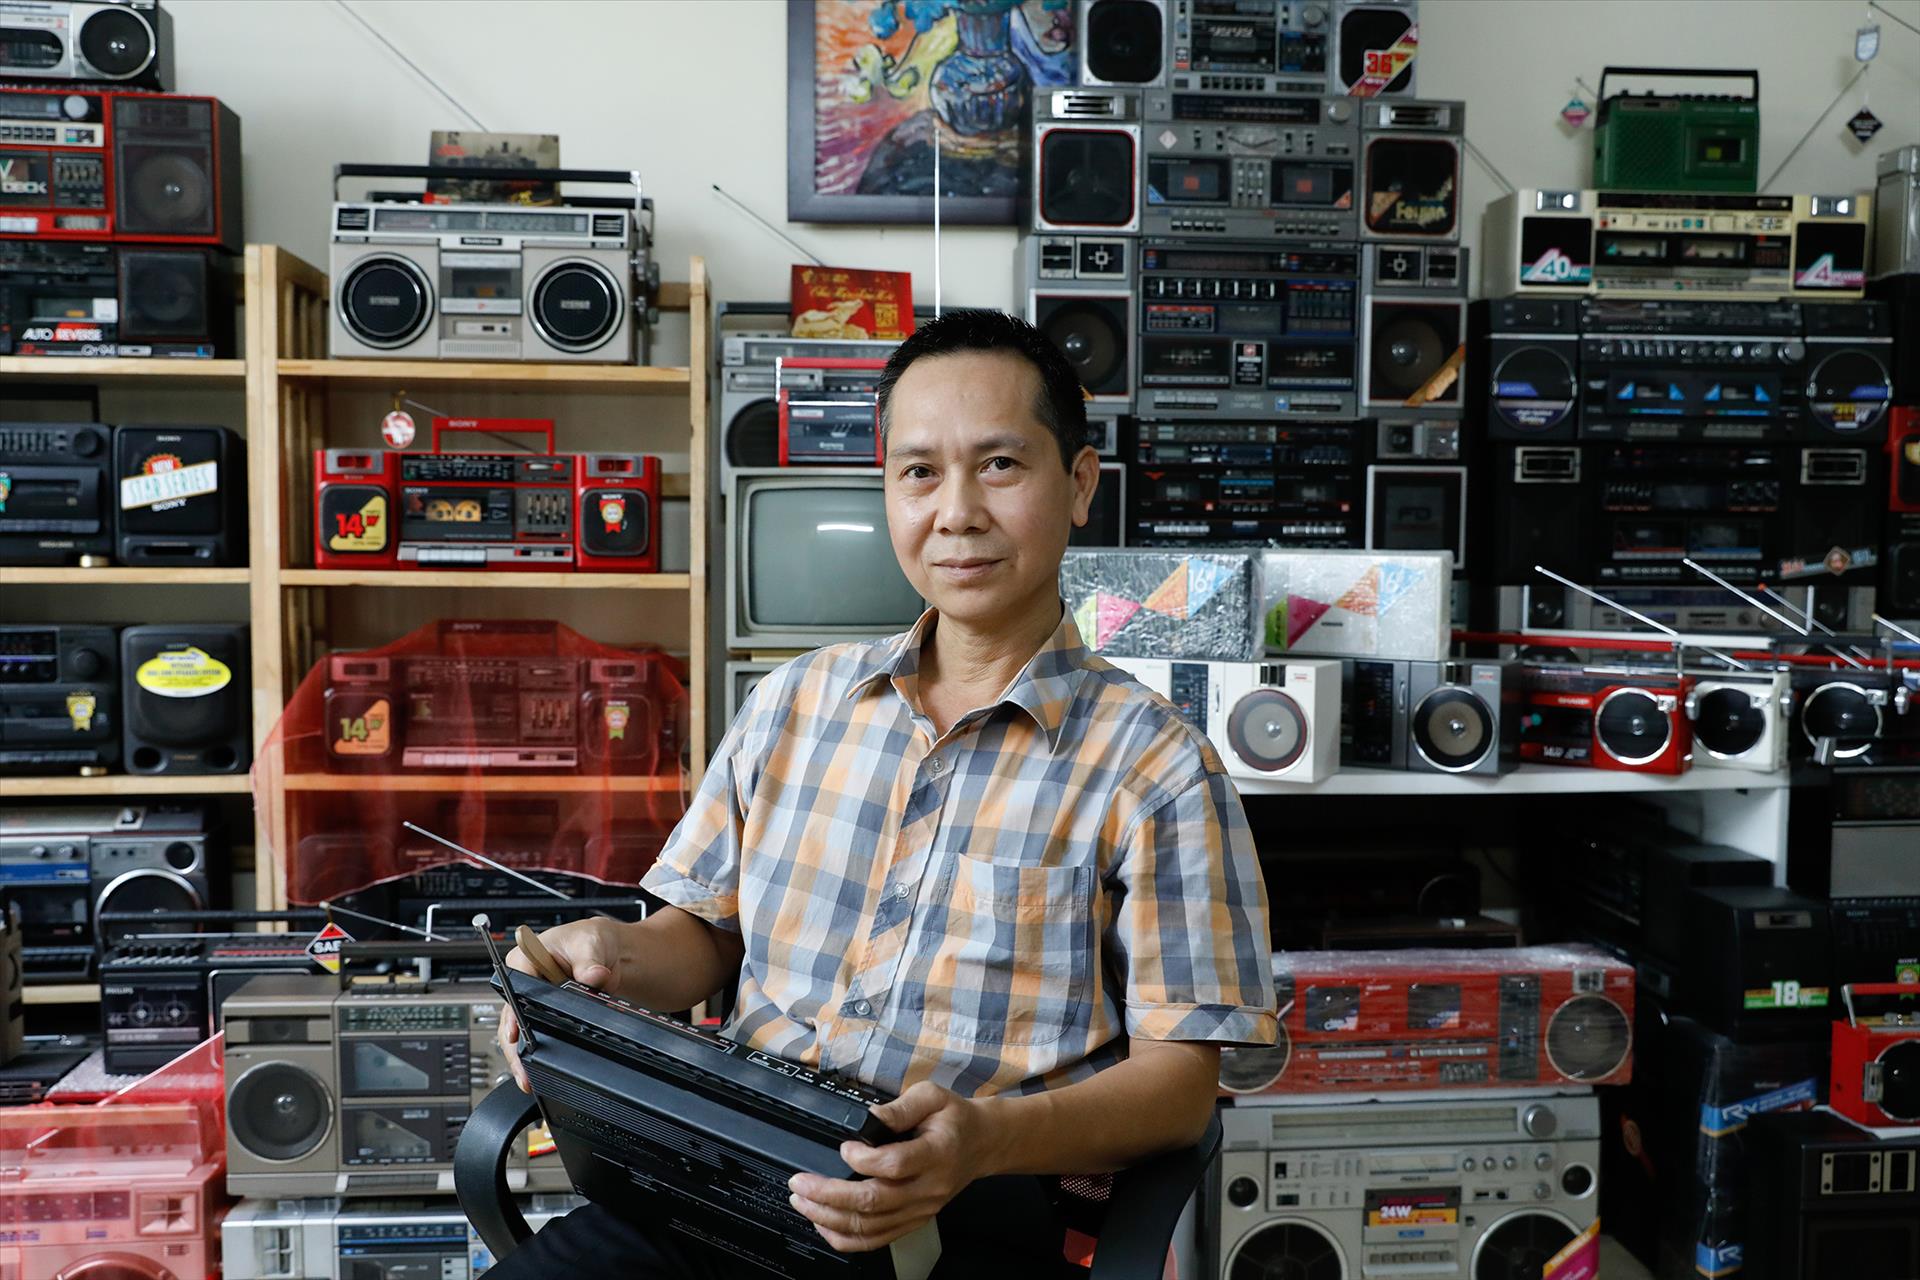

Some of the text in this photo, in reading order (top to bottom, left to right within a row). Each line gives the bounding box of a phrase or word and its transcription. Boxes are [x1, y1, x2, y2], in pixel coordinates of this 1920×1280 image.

[22, 328, 102, 341] AUTO REVERSE
[448, 419, 478, 428] SONY
[164, 466, 211, 500] SERIES
[151, 497, 186, 513] SONY
[452, 622, 482, 631] SONY
[105, 985, 134, 996] PHILIPS
[1381, 1204, 1412, 1219] 24W
